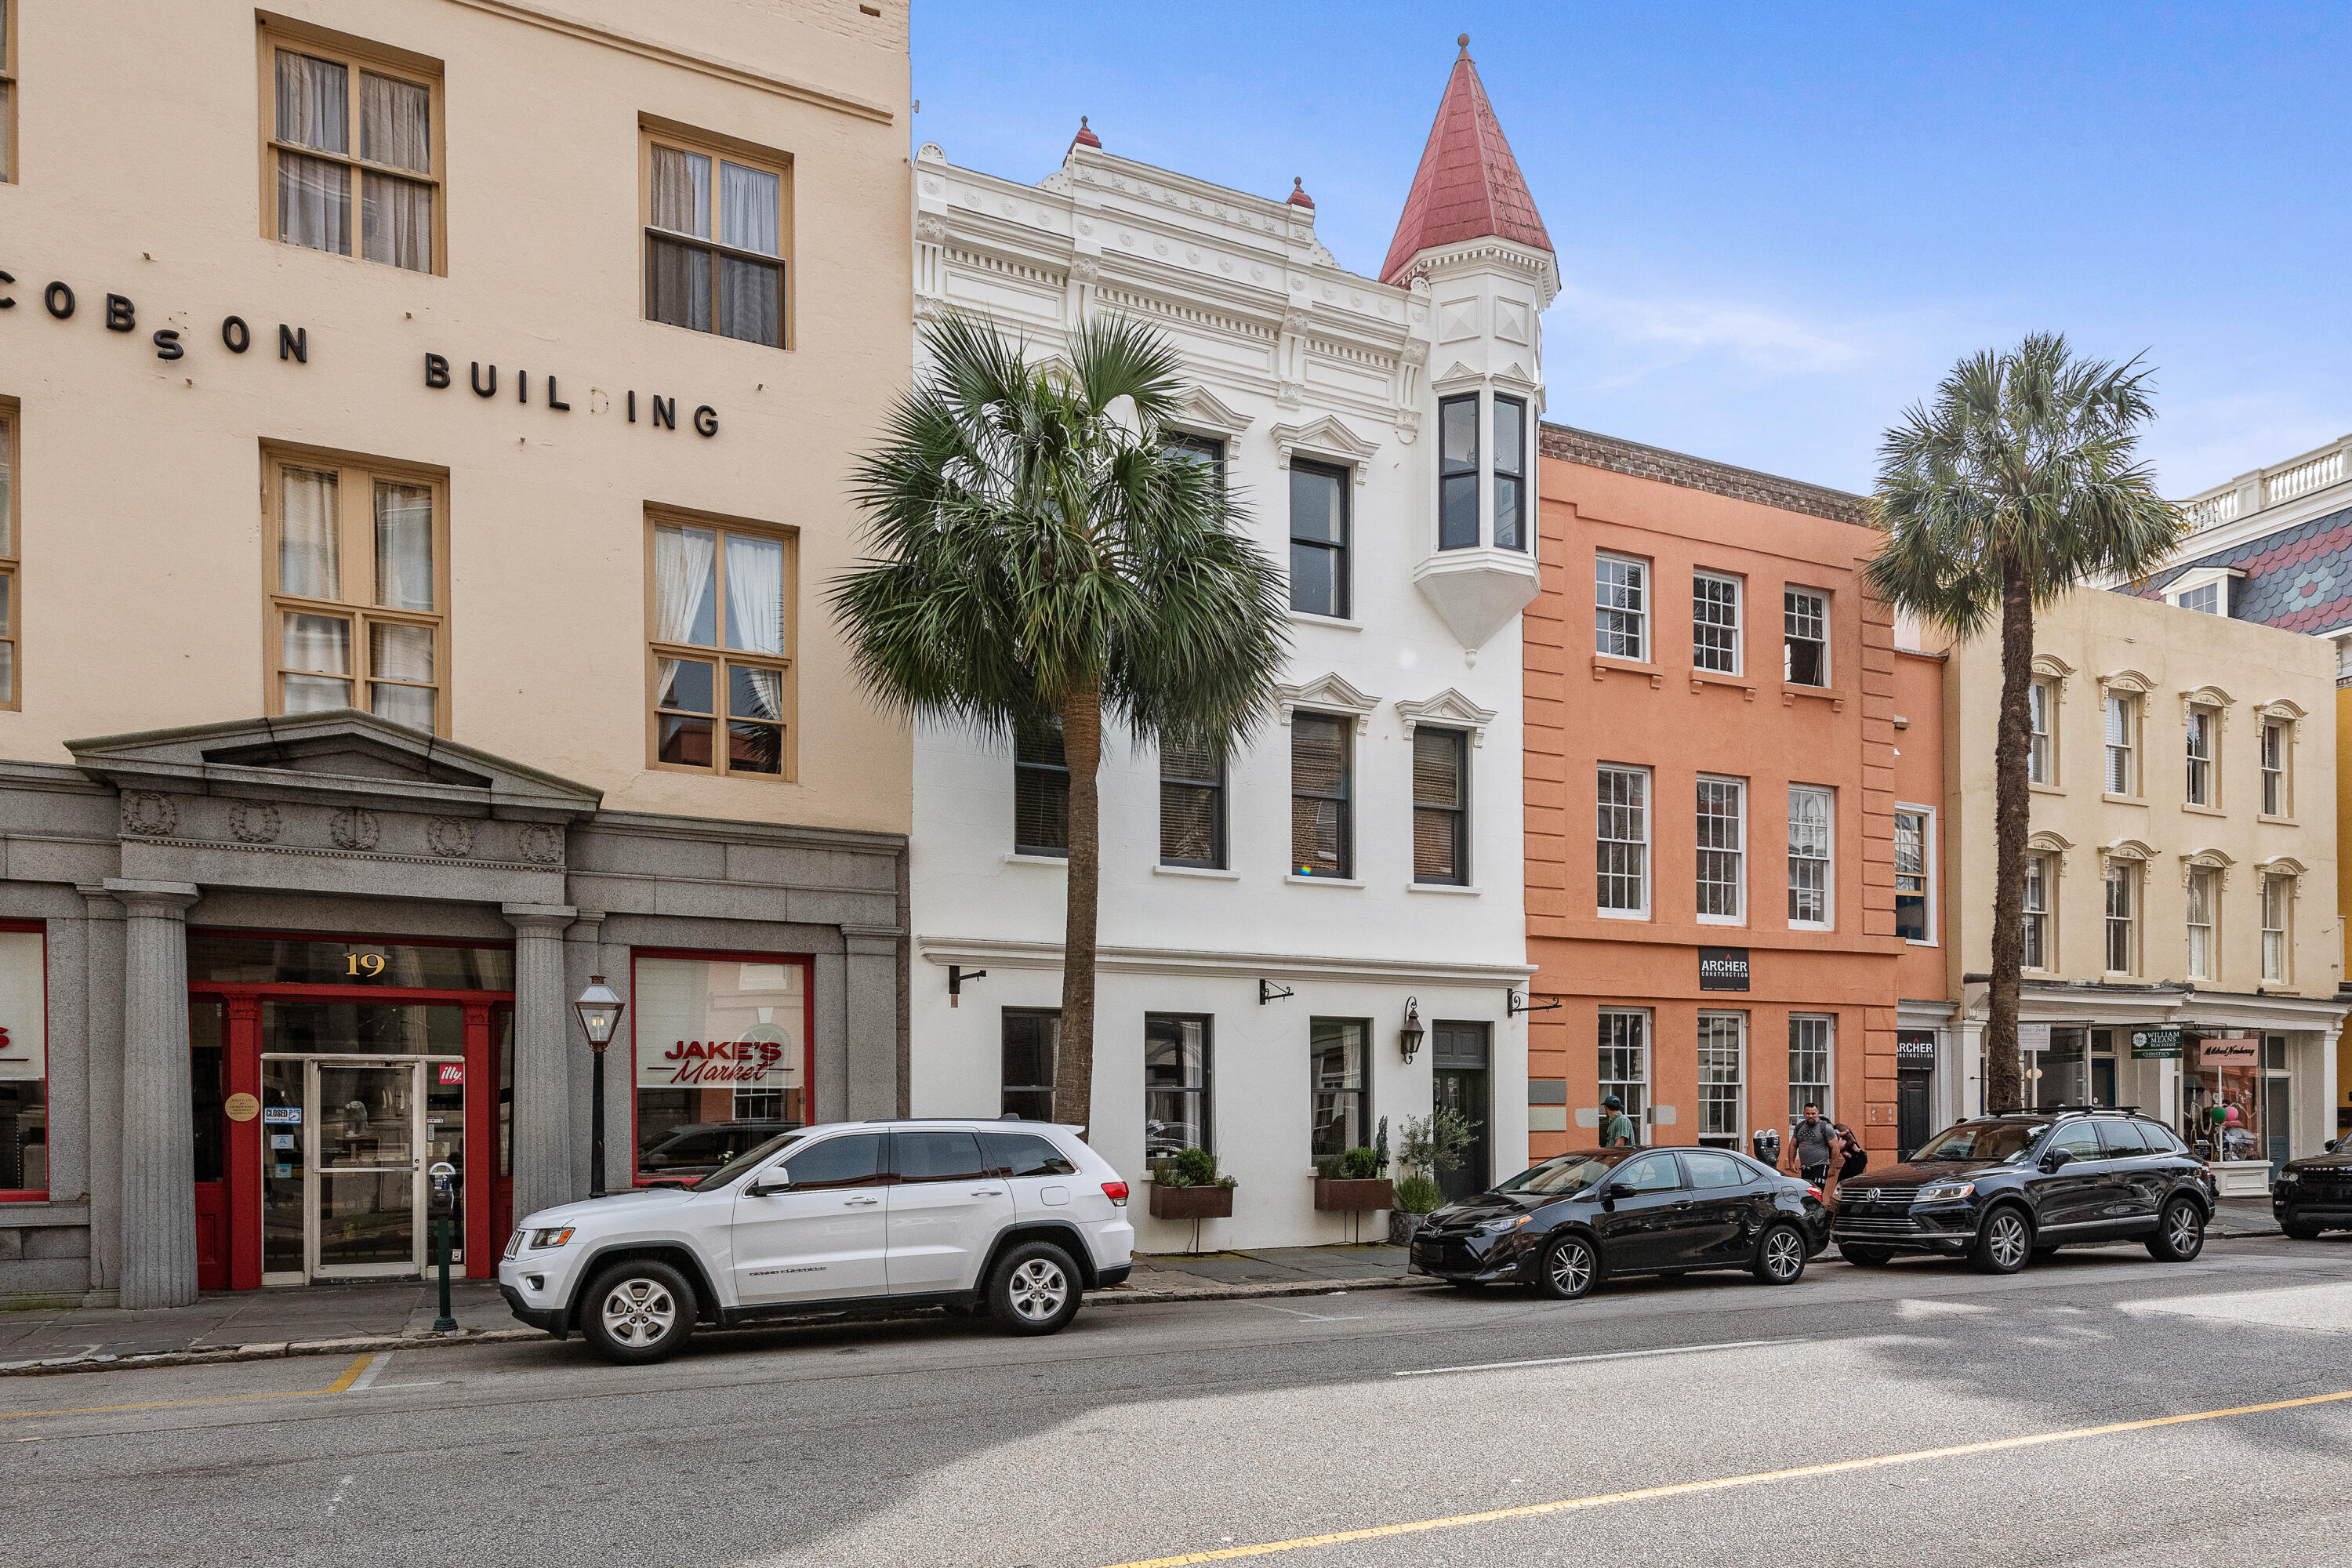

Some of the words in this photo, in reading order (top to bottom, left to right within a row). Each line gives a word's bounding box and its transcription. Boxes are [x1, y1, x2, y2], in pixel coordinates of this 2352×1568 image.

[424, 351, 719, 437] BUILING
[345, 953, 385, 977] 19
[1701, 960, 1748, 971] ARCHER
[665, 1040, 782, 1061] JAKE'S
[441, 1066, 463, 1082] illy
[670, 1058, 775, 1084] Market
[266, 1109, 288, 1117] CLOSED
